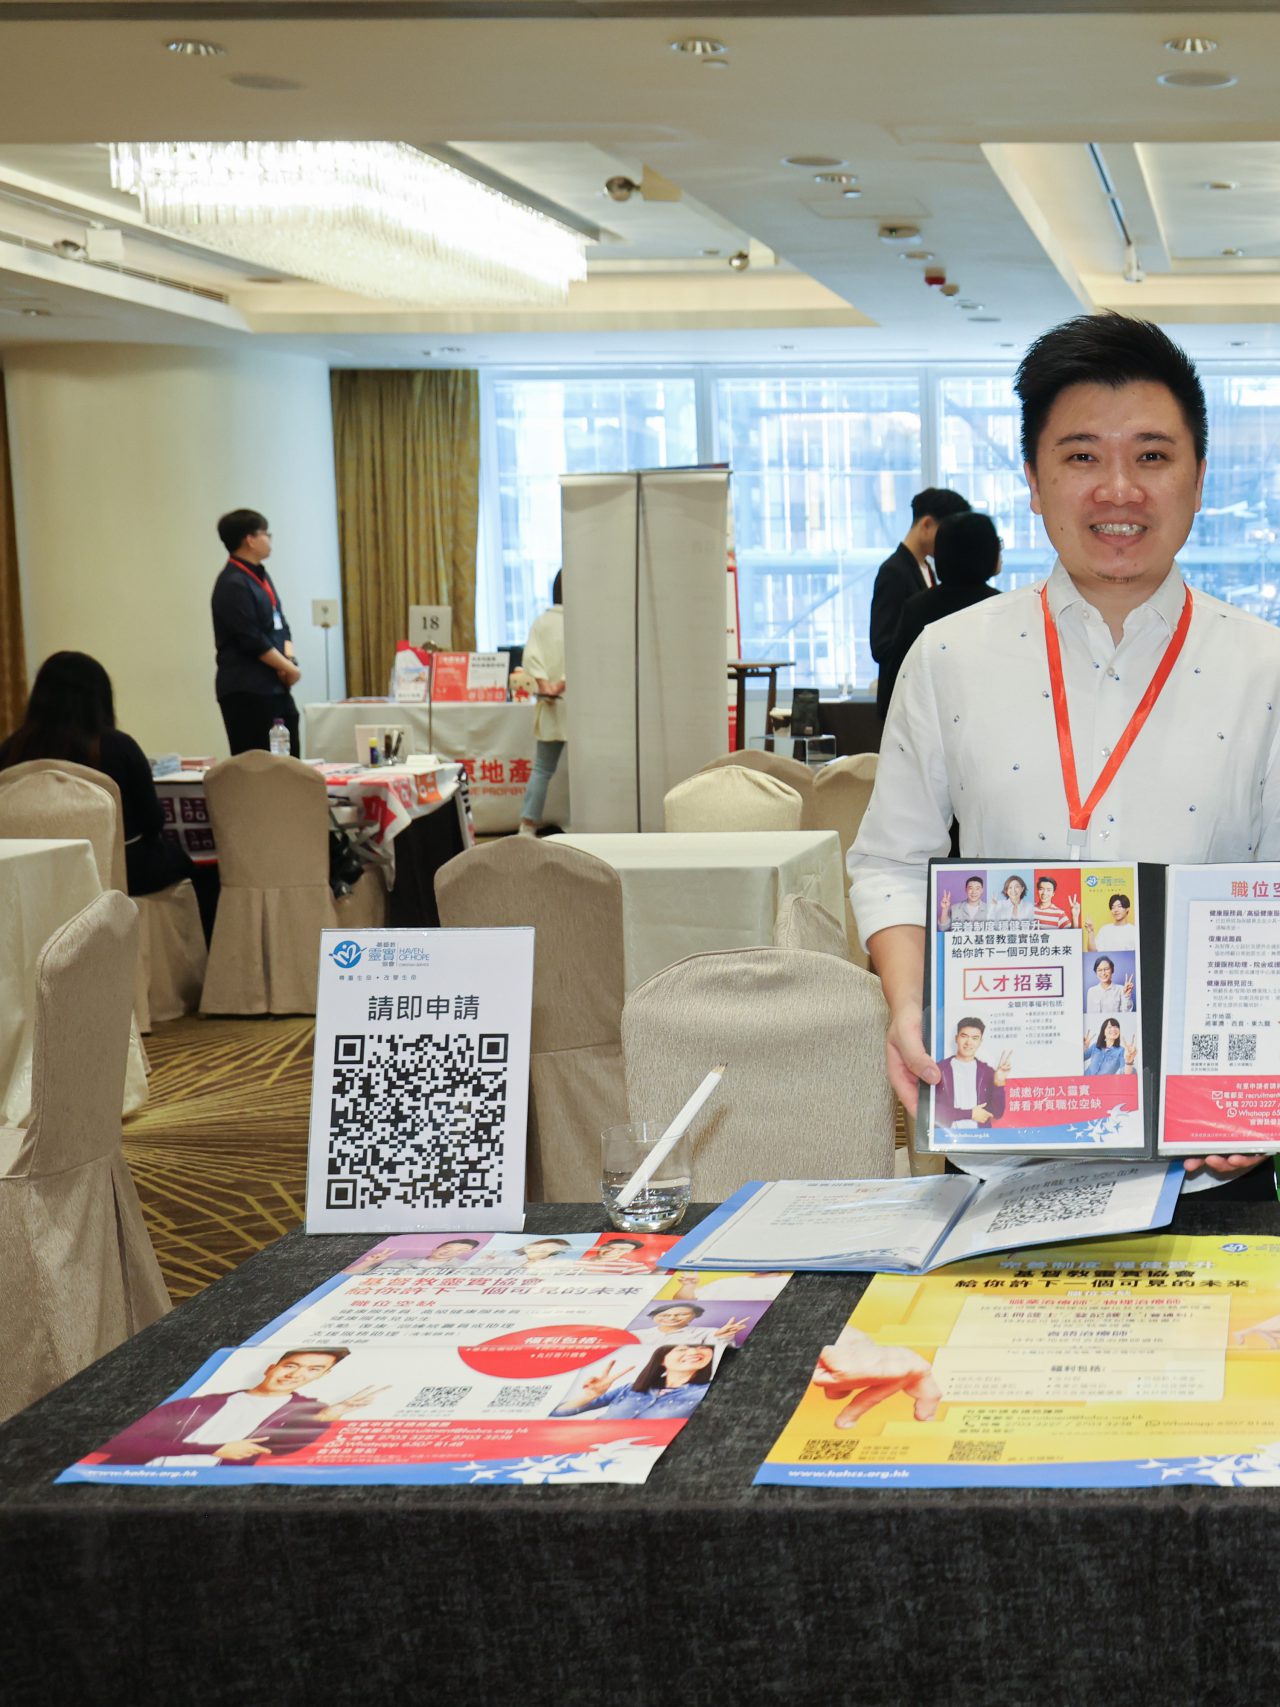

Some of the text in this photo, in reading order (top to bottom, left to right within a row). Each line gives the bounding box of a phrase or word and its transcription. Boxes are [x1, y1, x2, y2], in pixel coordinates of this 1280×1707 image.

[421, 615, 440, 631] 18
[951, 933, 1051, 946] 加入基督教靈實協會
[951, 946, 1073, 959] 給你許下一個可見的未來
[972, 973, 1053, 993] 人才招募
[368, 994, 480, 1022] 請即申請
[955, 1279, 1249, 1288] 給你許下一個可見的未來
